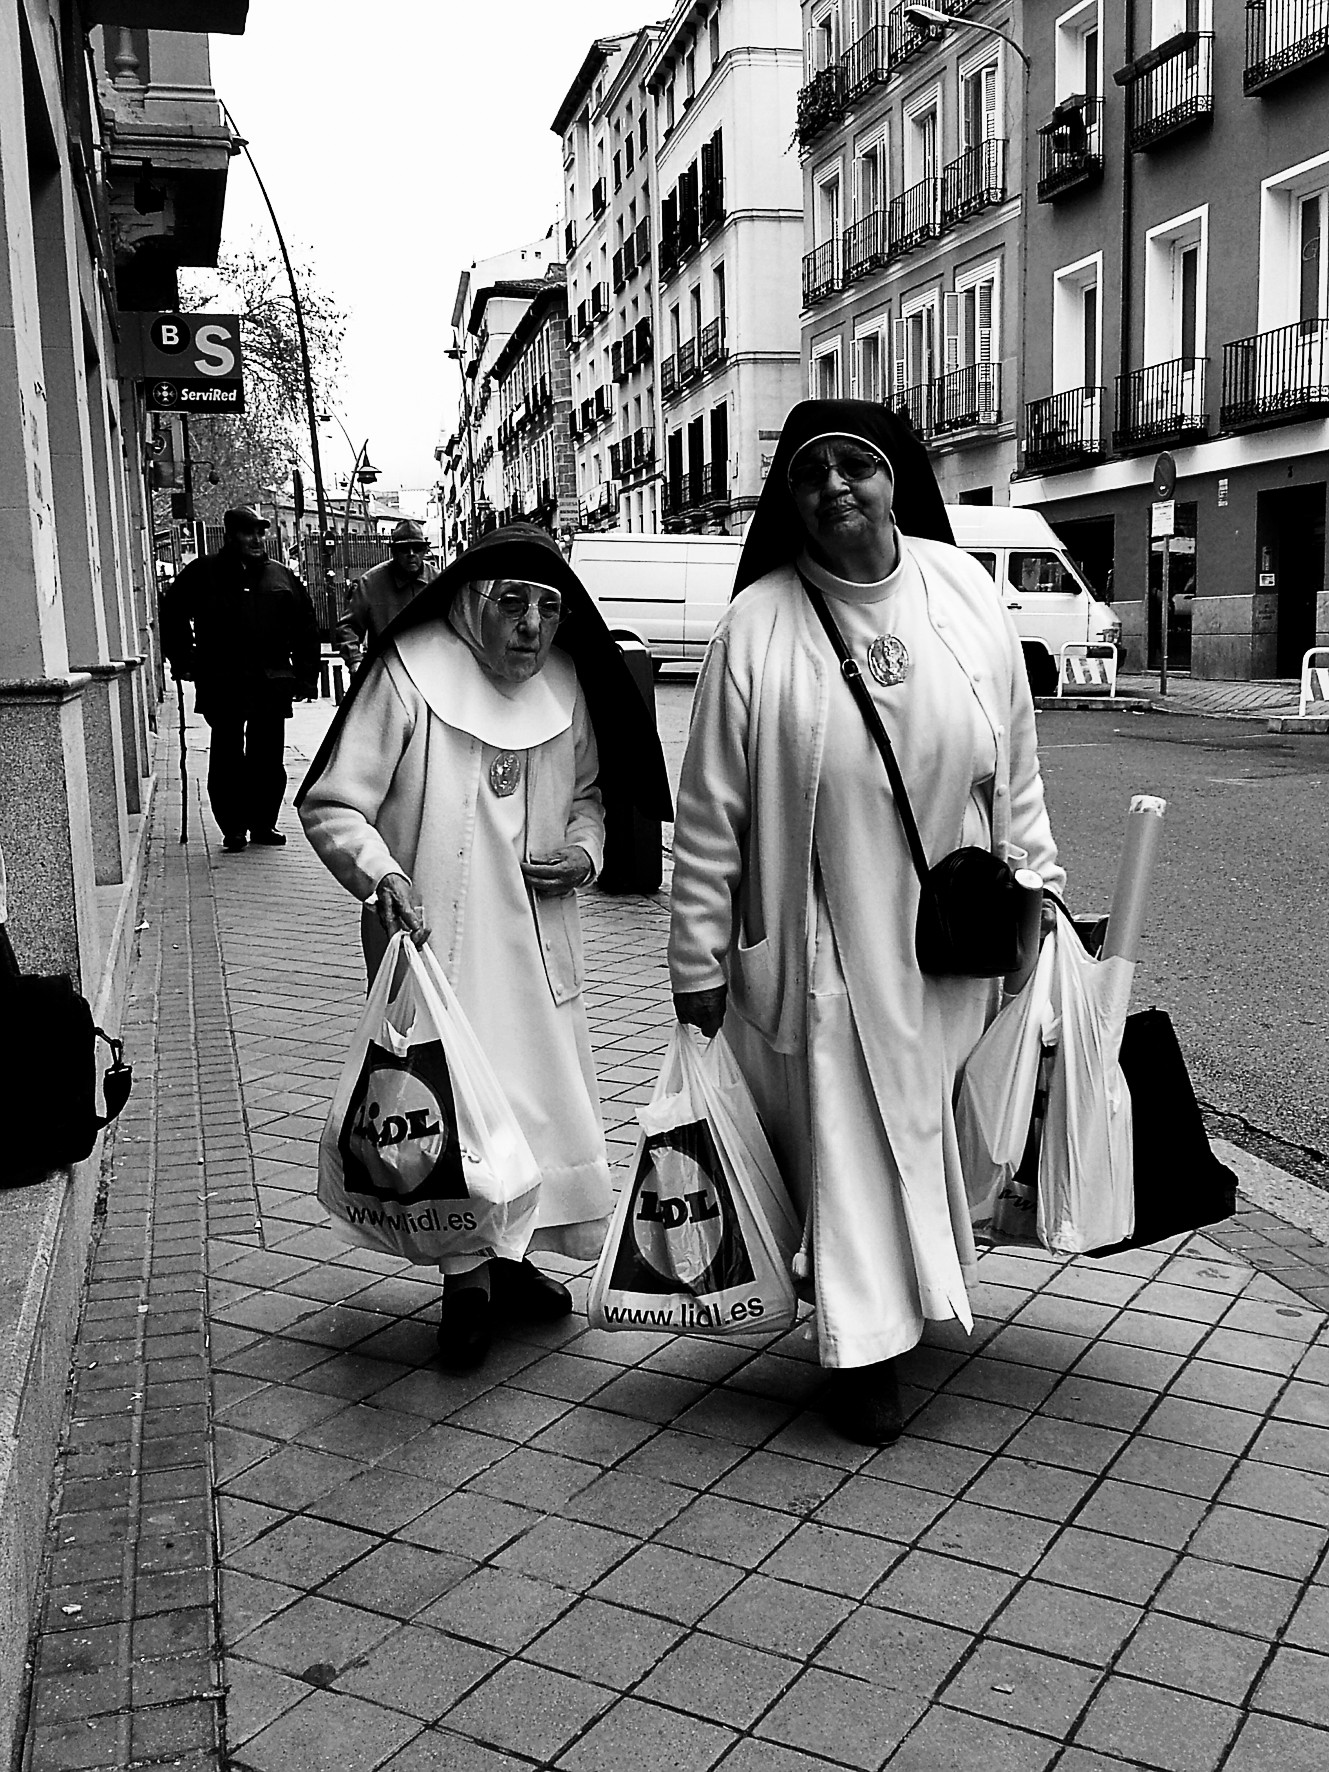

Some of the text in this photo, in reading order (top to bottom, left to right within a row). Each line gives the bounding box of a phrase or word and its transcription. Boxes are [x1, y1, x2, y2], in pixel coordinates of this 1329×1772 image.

[161, 325, 235, 376] B S
[181, 388, 238, 402] ServiRed
[604, 1296, 764, 1328] www.lidl.es
